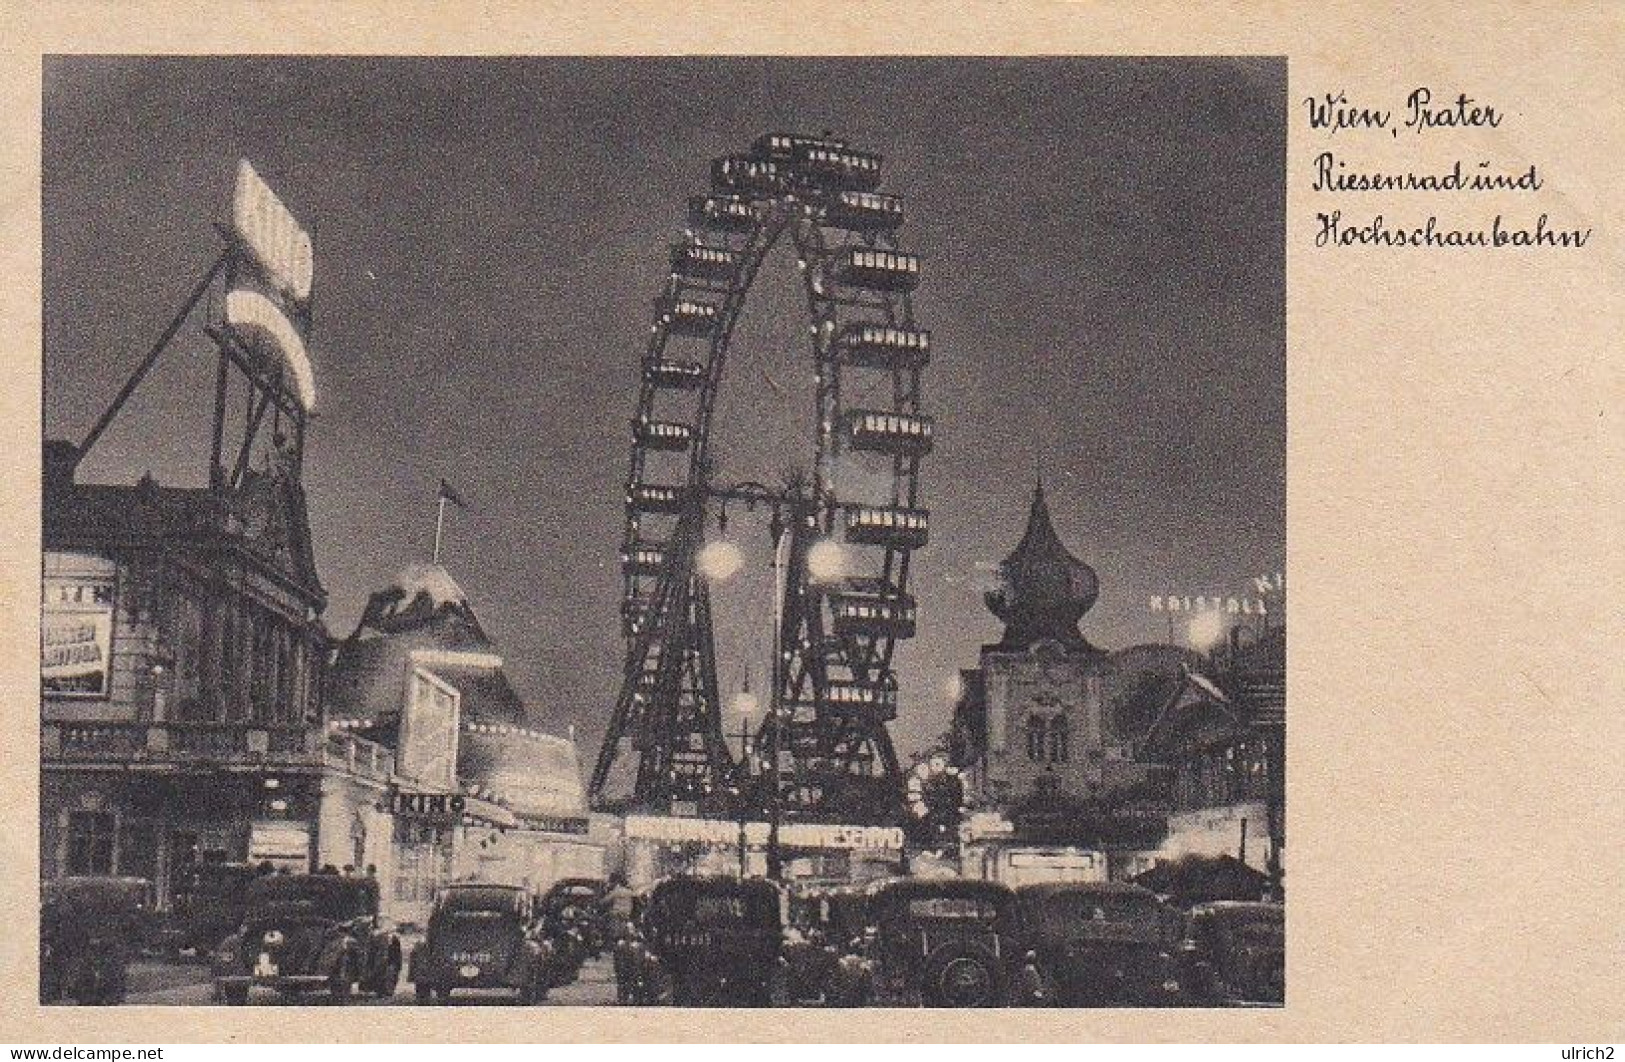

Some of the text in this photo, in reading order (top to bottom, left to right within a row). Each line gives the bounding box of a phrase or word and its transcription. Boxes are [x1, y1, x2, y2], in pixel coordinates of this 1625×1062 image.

[1303, 88, 1503, 137] Wien, Prater
[1312, 152, 1469, 191] Riesenrad
[1315, 210, 1592, 247] Hochschaubahn
